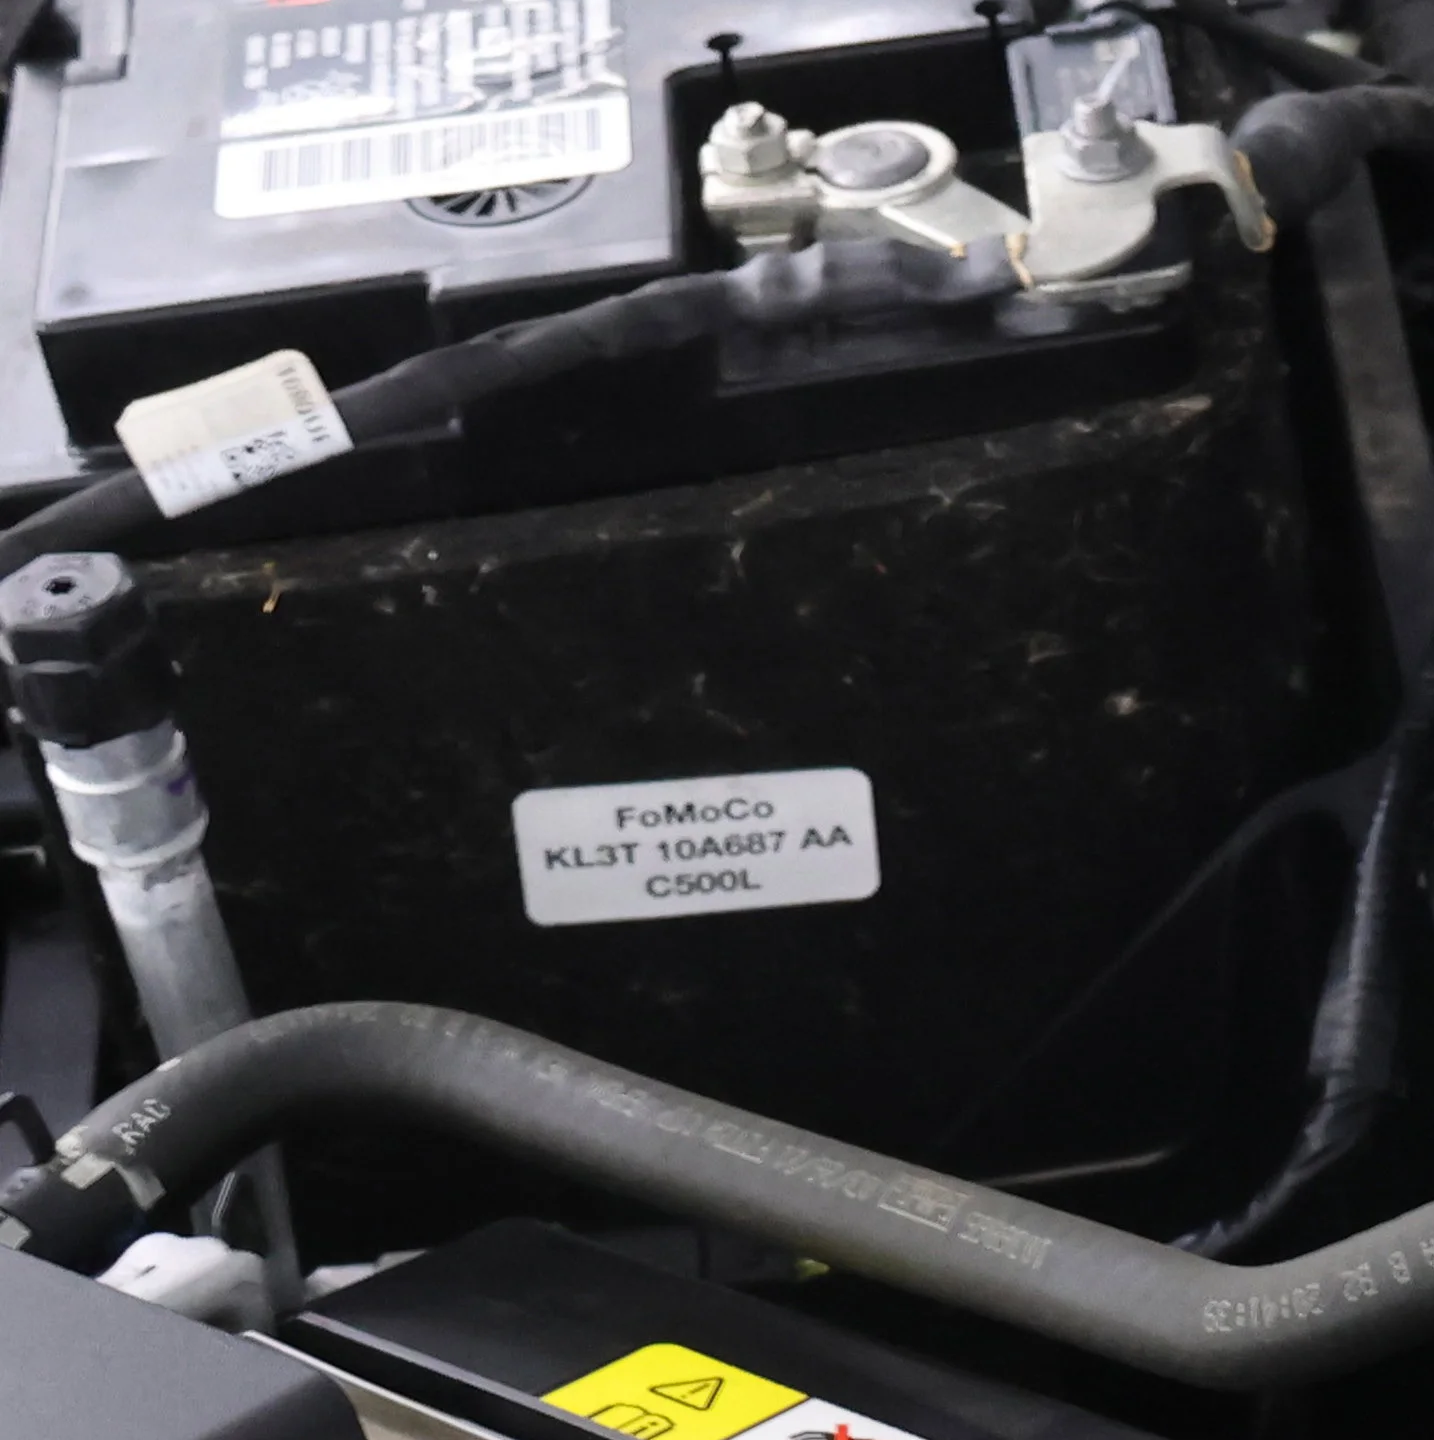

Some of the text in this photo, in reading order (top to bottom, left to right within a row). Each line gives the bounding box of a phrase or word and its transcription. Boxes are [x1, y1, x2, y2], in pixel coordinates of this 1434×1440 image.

[614, 797, 775, 831] FoMoCo
[543, 824, 853, 871] KL3T 10A687 AA
[645, 868, 762, 898] C500L
